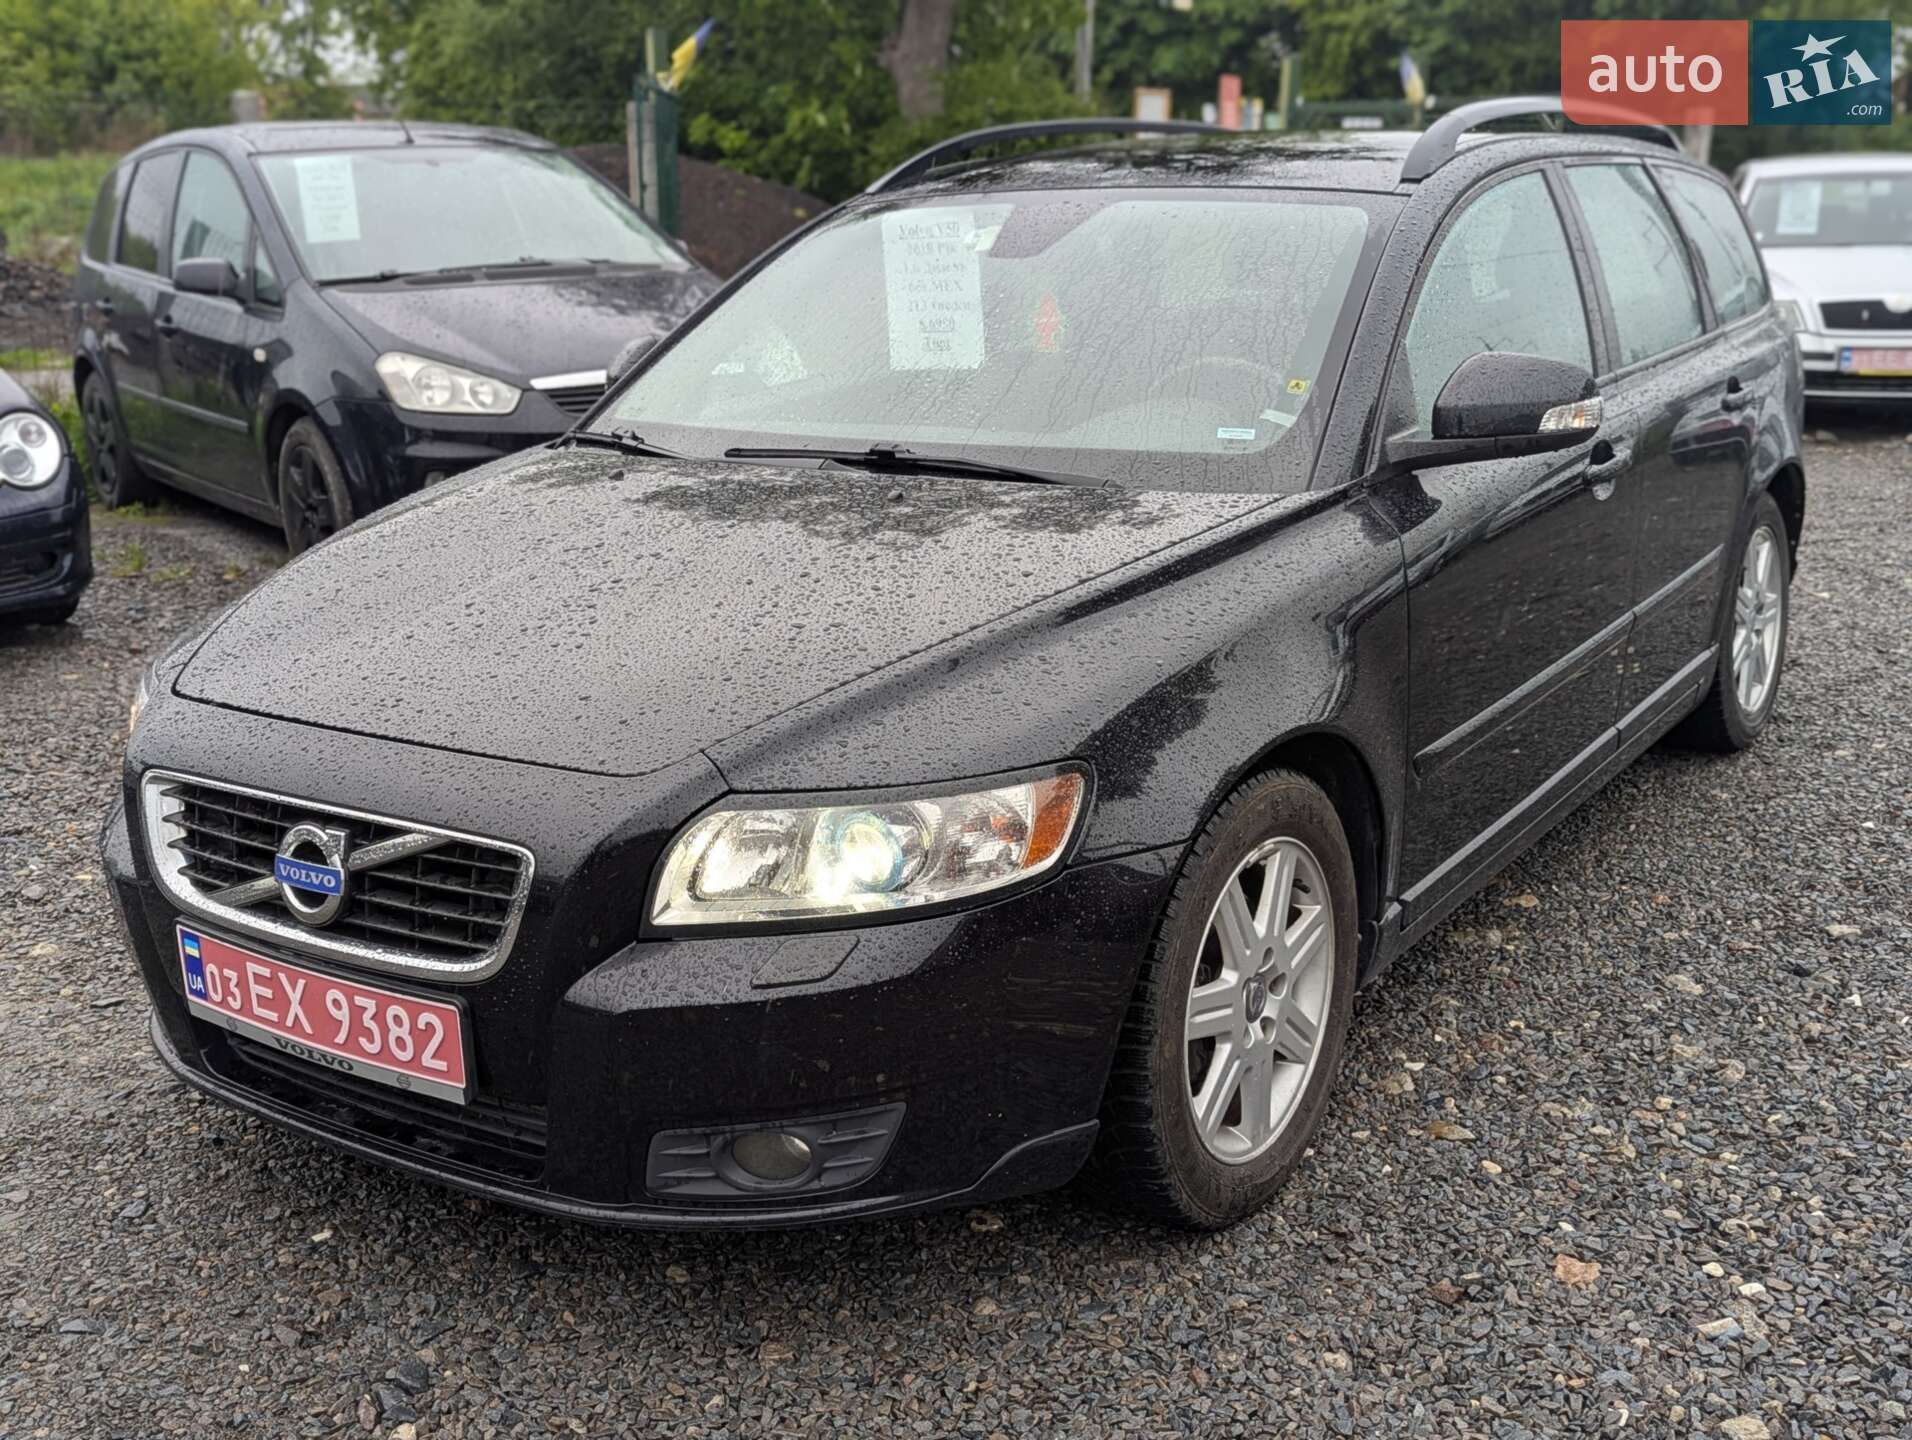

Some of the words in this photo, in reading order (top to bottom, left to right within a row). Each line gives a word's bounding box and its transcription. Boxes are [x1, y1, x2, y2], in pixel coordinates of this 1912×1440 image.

[279, 863, 336, 888] VOLVO
[188, 972, 205, 993] UA
[325, 989, 448, 1072] 9382
[272, 1036, 354, 1072] VOLVO
